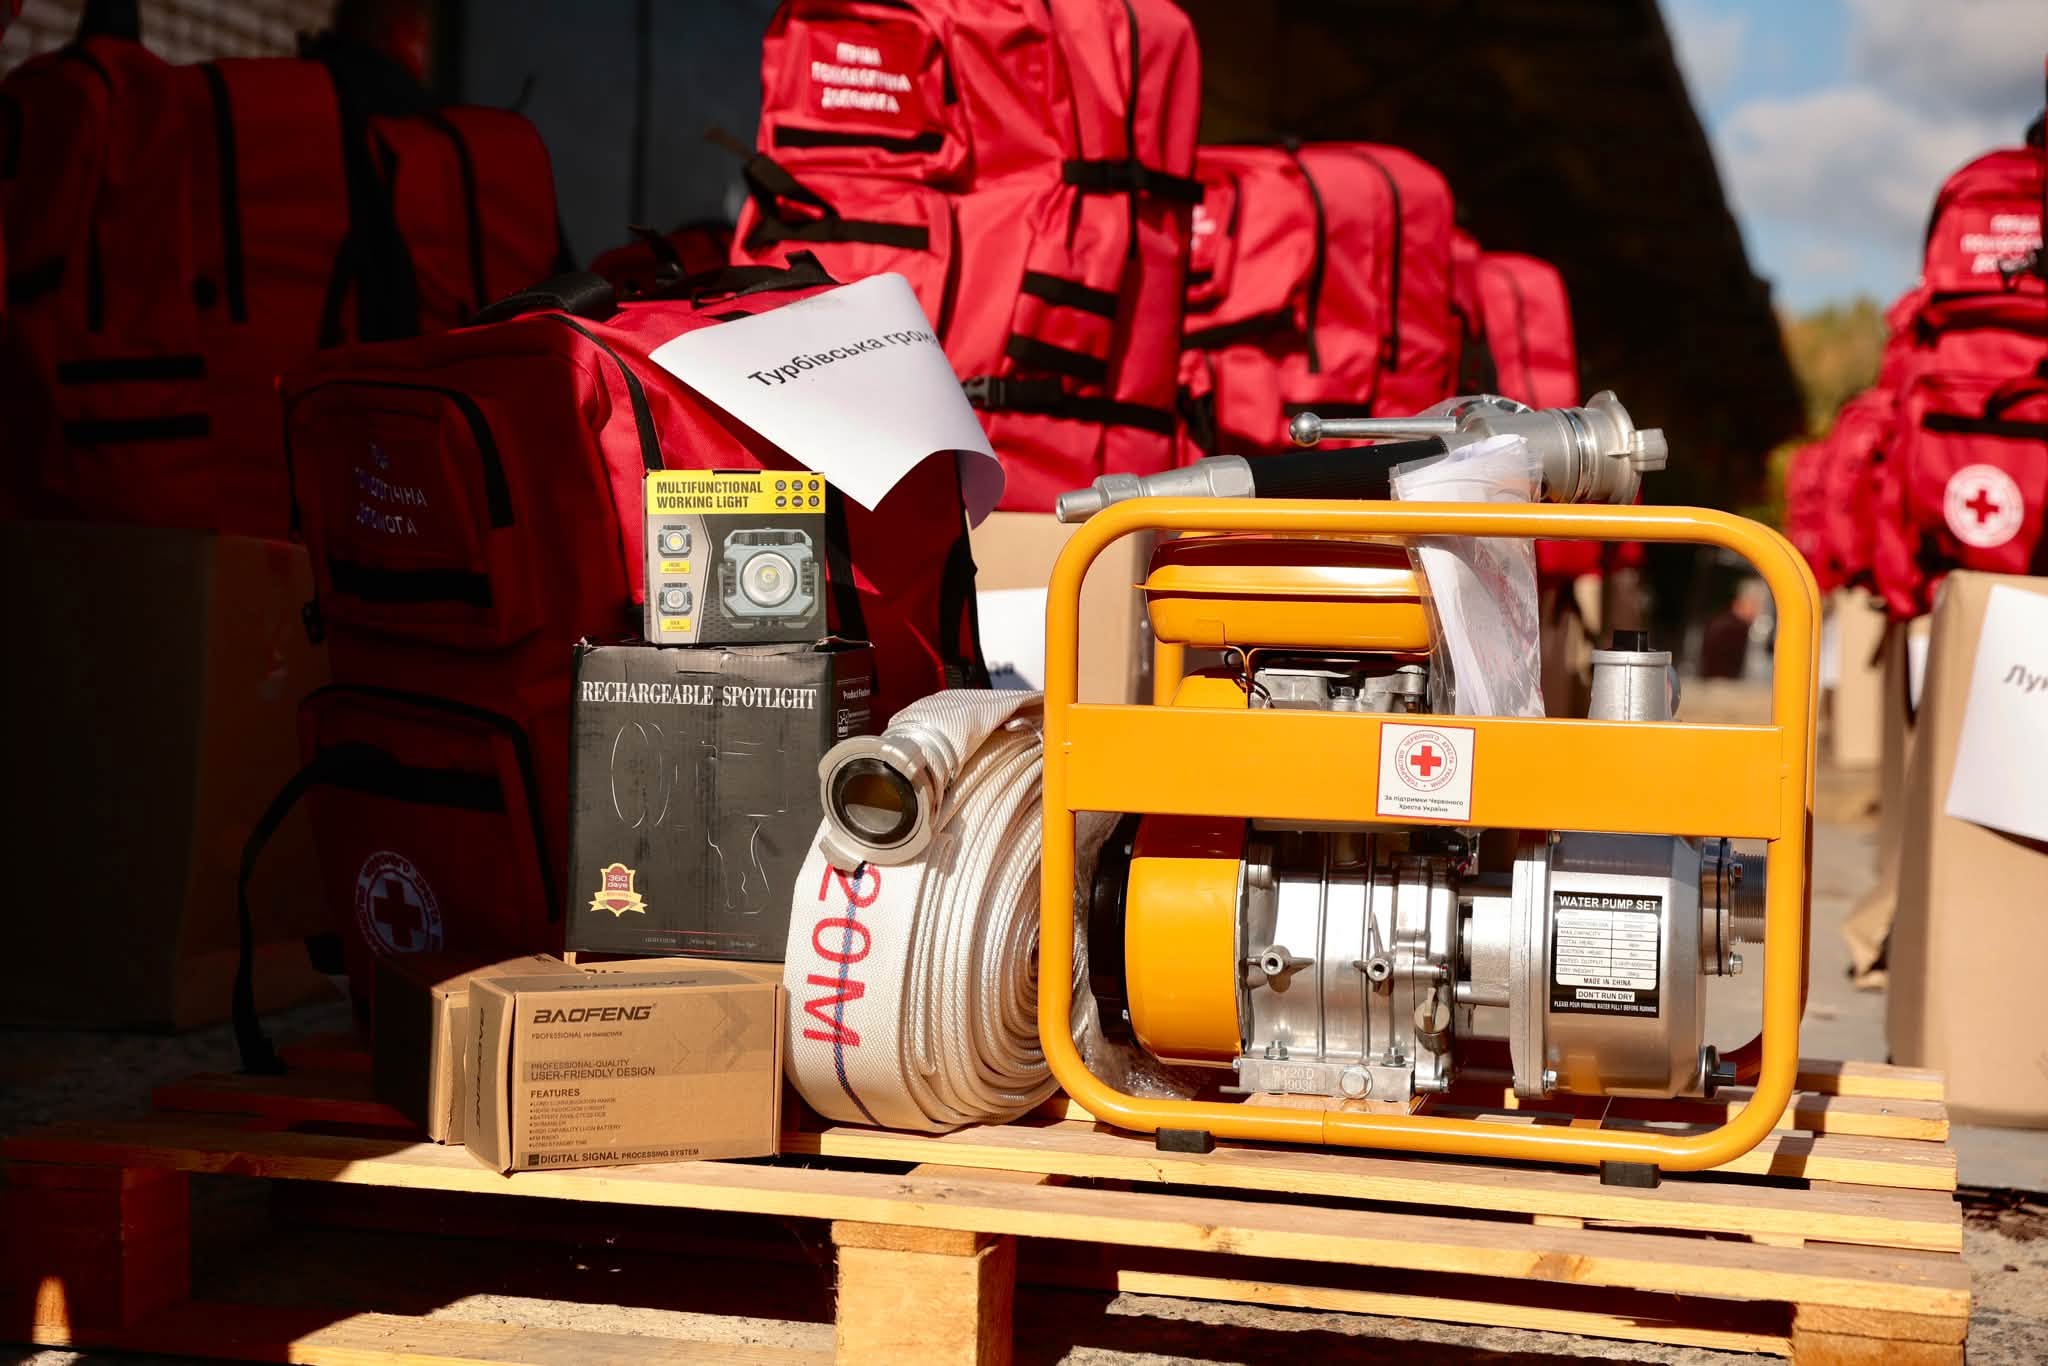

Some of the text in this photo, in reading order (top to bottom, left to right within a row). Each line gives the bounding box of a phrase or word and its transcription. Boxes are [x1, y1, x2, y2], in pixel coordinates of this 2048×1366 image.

[748, 337, 885, 386] Турбівська
[656, 481, 763, 494] MULTIFUNCTIONAL
[656, 496, 749, 508] WORKING LIGHT
[582, 681, 817, 709] RECHARGEABLE SPOTLIGHT
[1560, 895, 1658, 911] WATER PUMP SET
[1583, 977, 1600, 985] MADE
[1577, 991, 1633, 1001] DON'T RUN DRY
[533, 1006, 653, 1024] BAOFENG
[532, 1031, 582, 1040] PROFESSIONAL
[531, 1059, 630, 1071] PROFESSIONAL-QUALITY
[531, 1066, 656, 1081] USER-FRIENDLY DESIGN
[531, 1088, 580, 1098] FEATURES
[540, 1148, 699, 1164] DIGITAL SIGNAL PROCESSING SYSTEM
